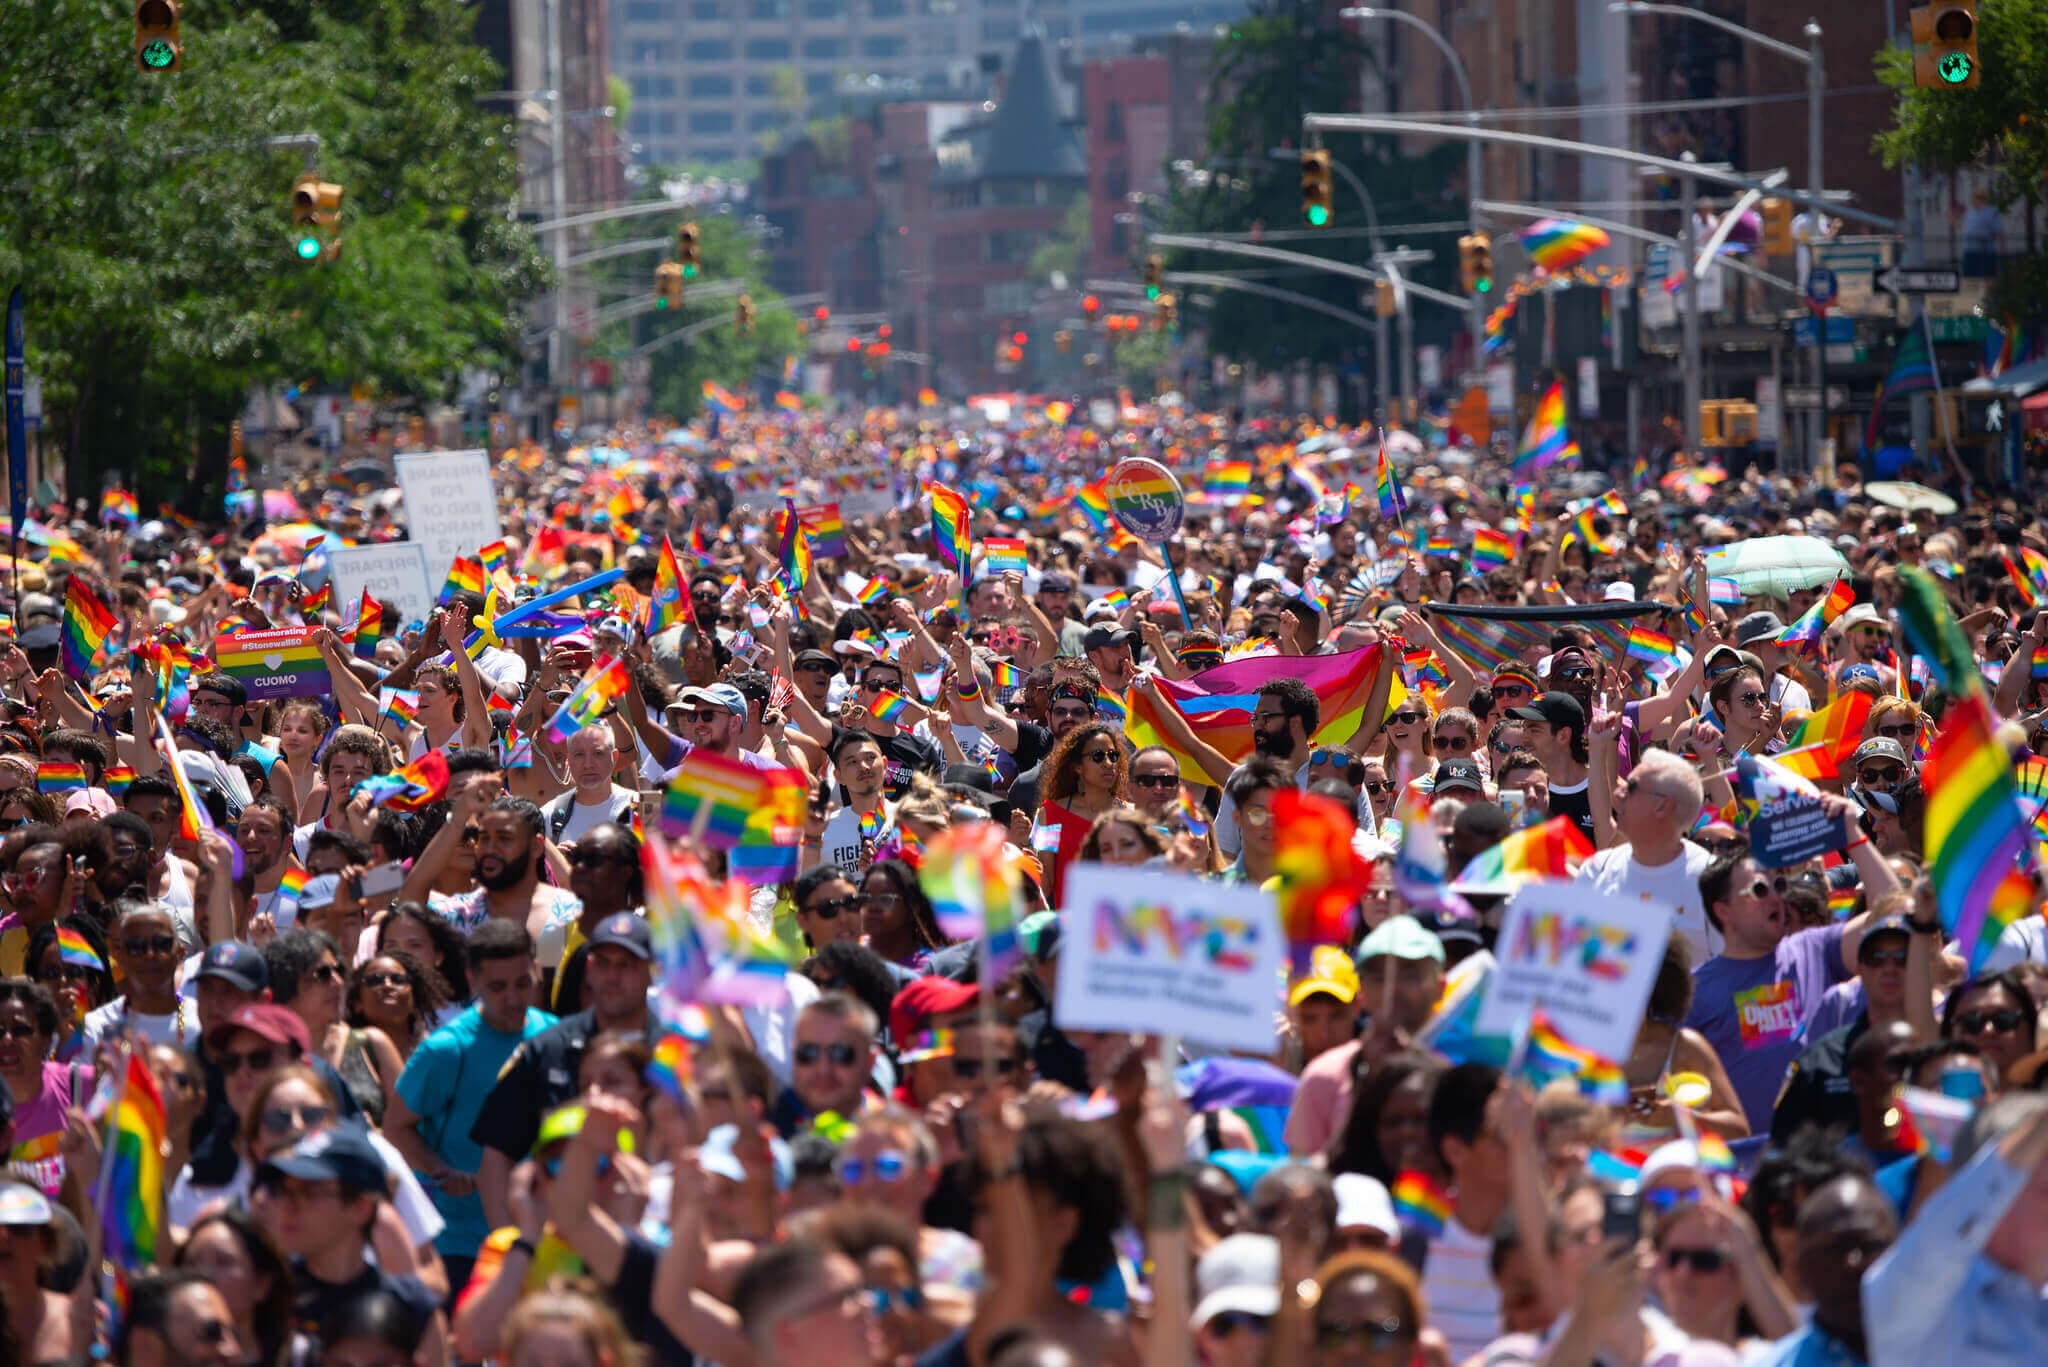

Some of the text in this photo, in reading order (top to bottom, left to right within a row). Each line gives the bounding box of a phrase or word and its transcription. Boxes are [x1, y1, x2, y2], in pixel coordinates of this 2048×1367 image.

[234, 627, 307, 640] Commemorating
[241, 638, 302, 651] #Stonewall50
[254, 675, 297, 687] CUOMO
[1760, 795, 1819, 818] Servic
